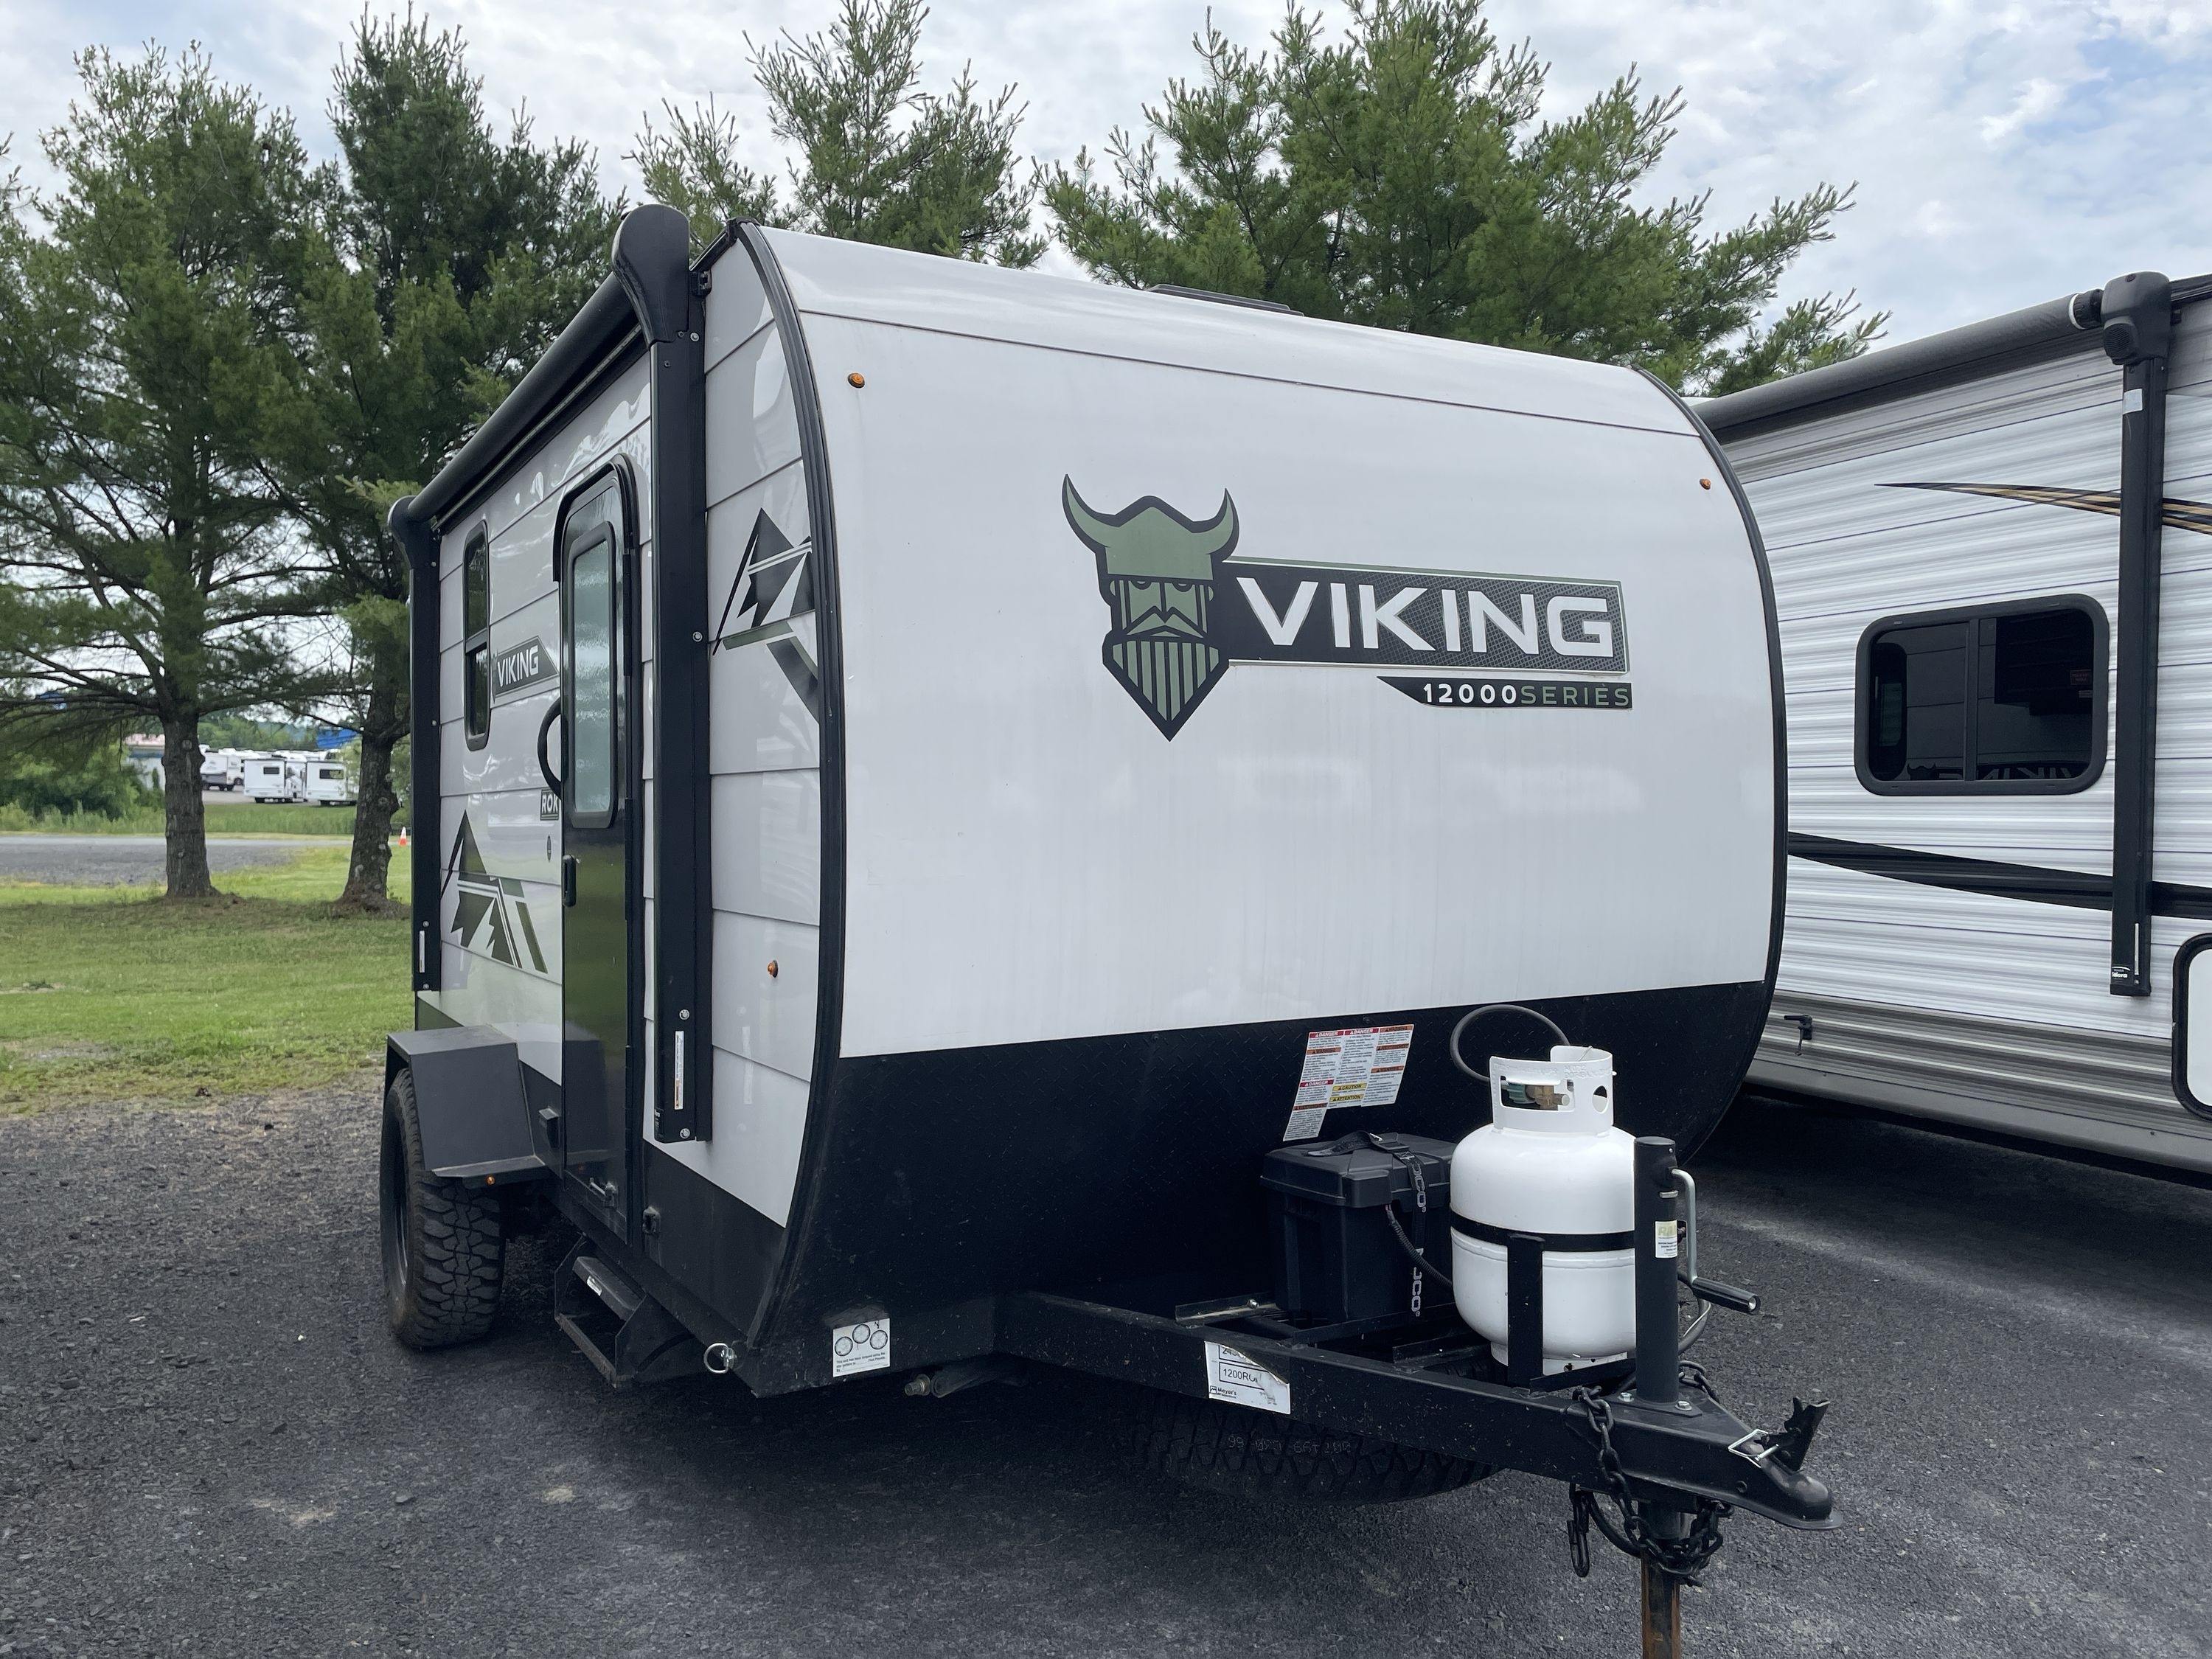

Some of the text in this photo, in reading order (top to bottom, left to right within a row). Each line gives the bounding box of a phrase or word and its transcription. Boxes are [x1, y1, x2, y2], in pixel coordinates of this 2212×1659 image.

[1237, 577, 1615, 658] VIKING
[498, 644, 539, 687] VIKING
[541, 793, 558, 813] ROK
